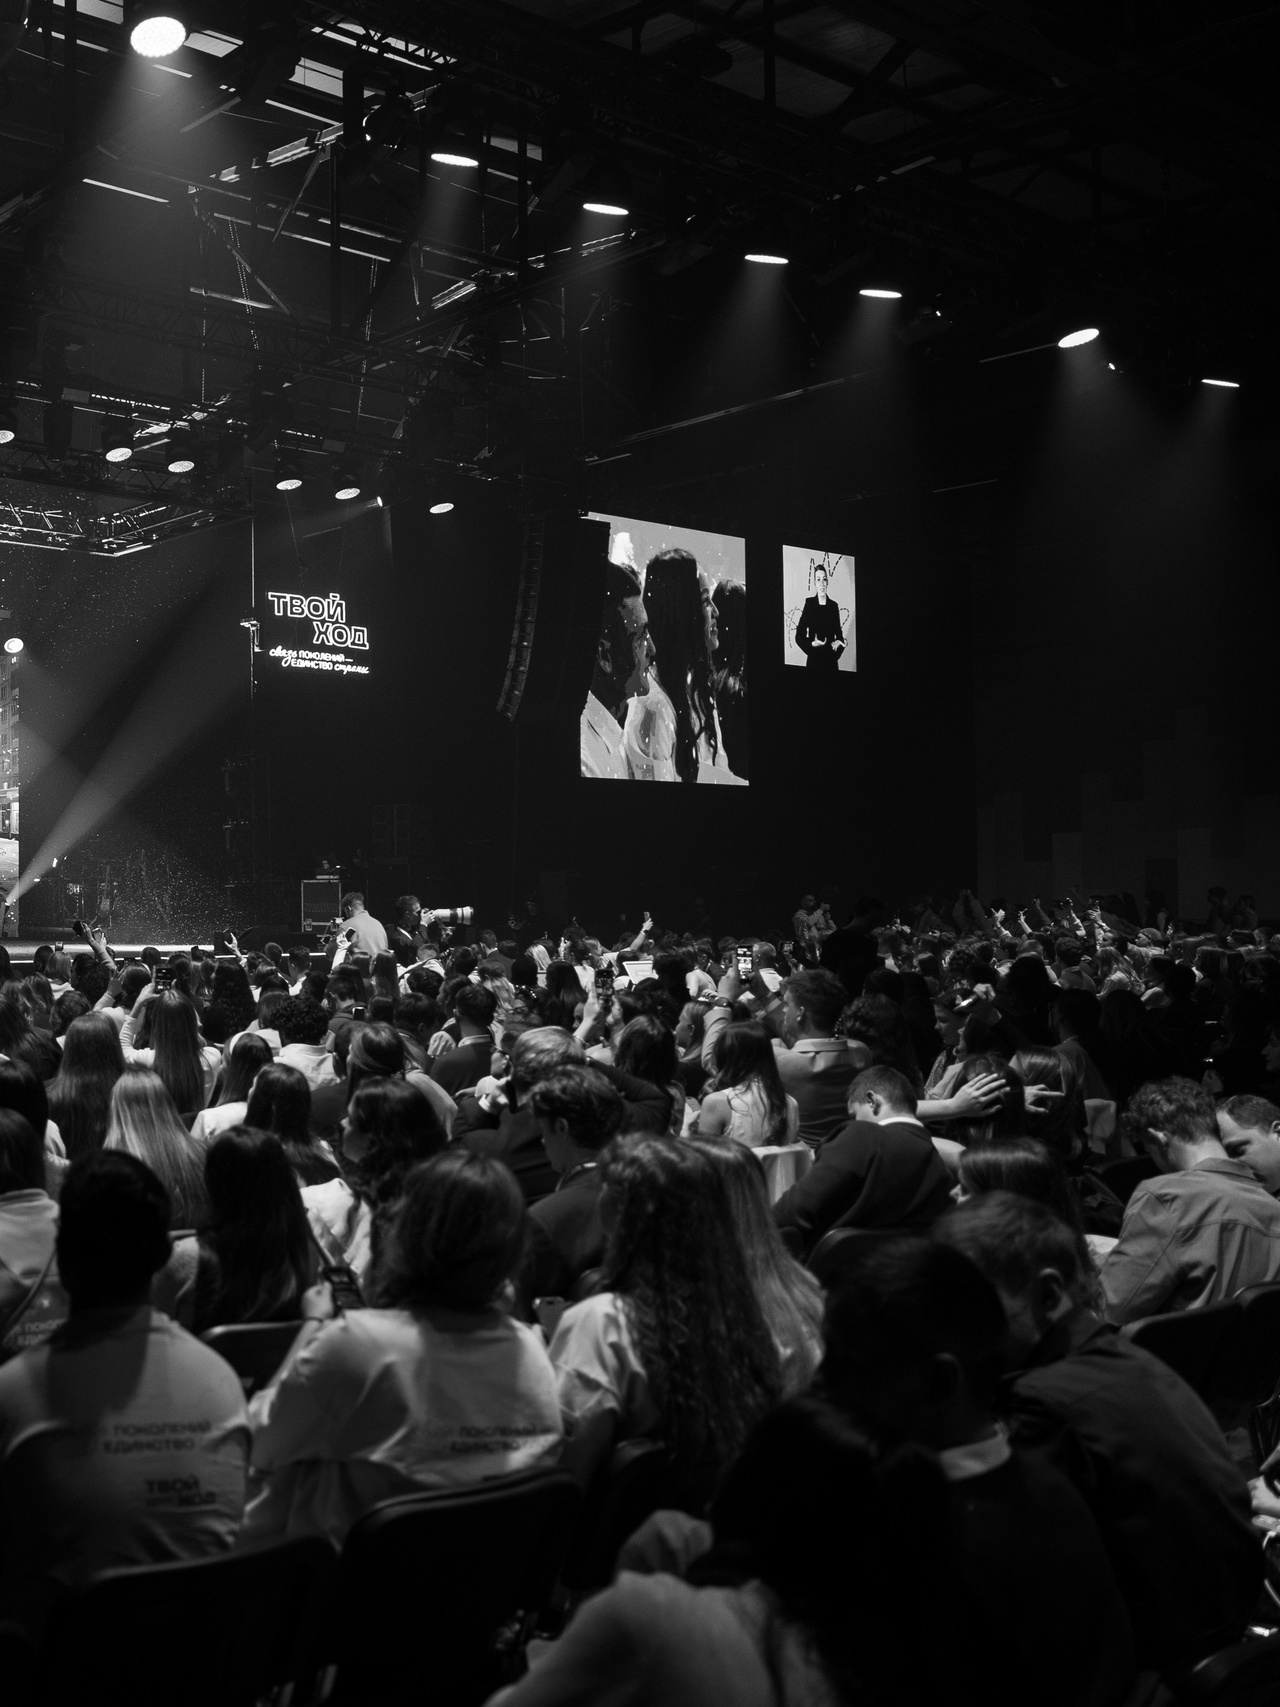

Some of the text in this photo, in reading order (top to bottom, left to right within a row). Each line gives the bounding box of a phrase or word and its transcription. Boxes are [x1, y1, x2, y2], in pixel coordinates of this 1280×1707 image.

[267, 592, 346, 623] ТВОЙ
[312, 621, 370, 650] ХОД
[291, 658, 370, 675] ЕДИНСТВО страны
[145, 1473, 200, 1494] ТВОЙ
